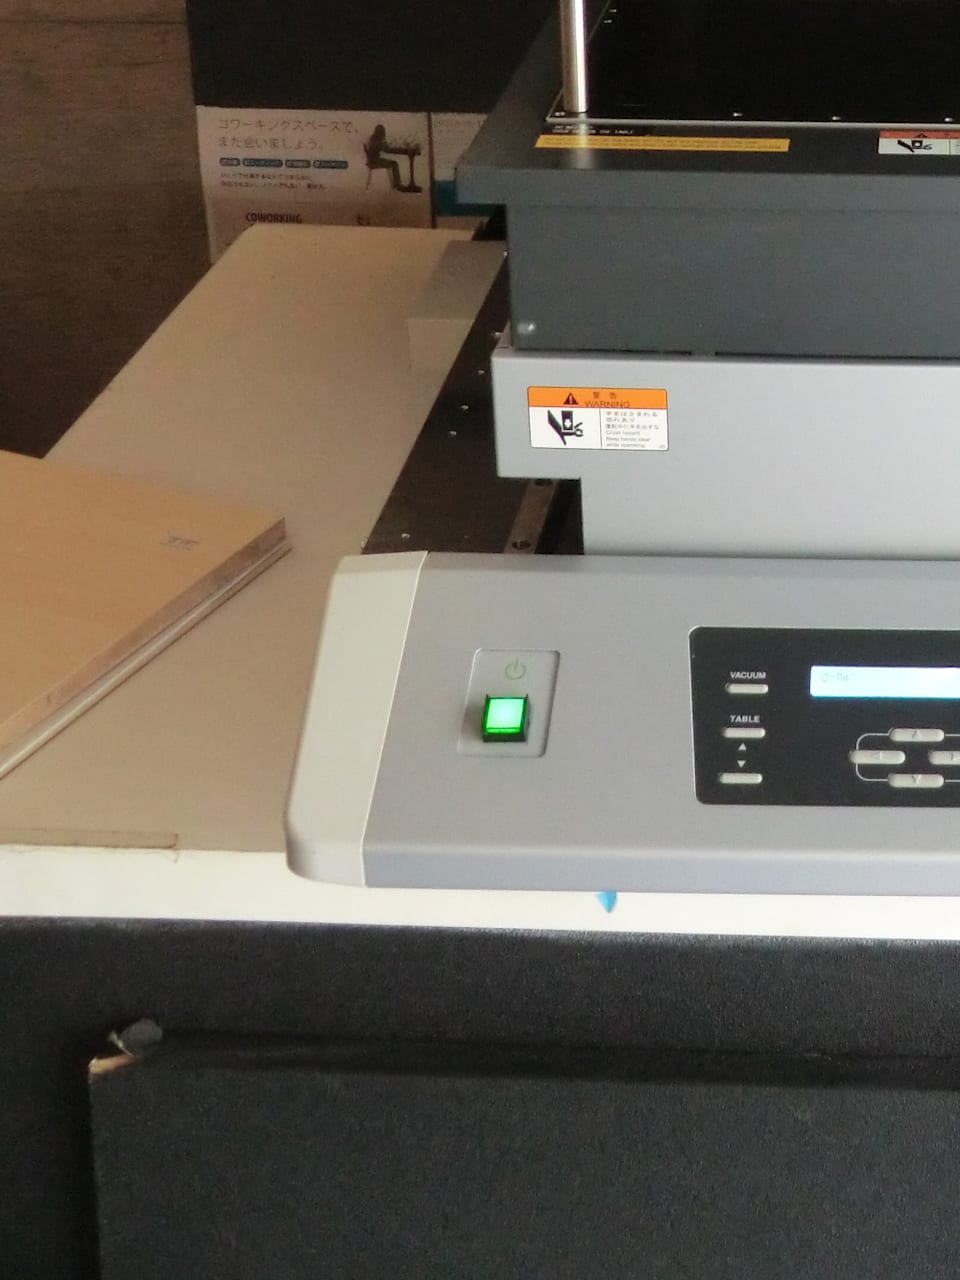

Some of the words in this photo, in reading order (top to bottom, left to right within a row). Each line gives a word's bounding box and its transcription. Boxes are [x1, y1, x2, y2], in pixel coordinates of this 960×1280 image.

[245, 212, 303, 223] COWORKING
[585, 400, 630, 408] WARNING
[729, 671, 767, 680] VACUUM
[729, 715, 761, 723] TABLE
